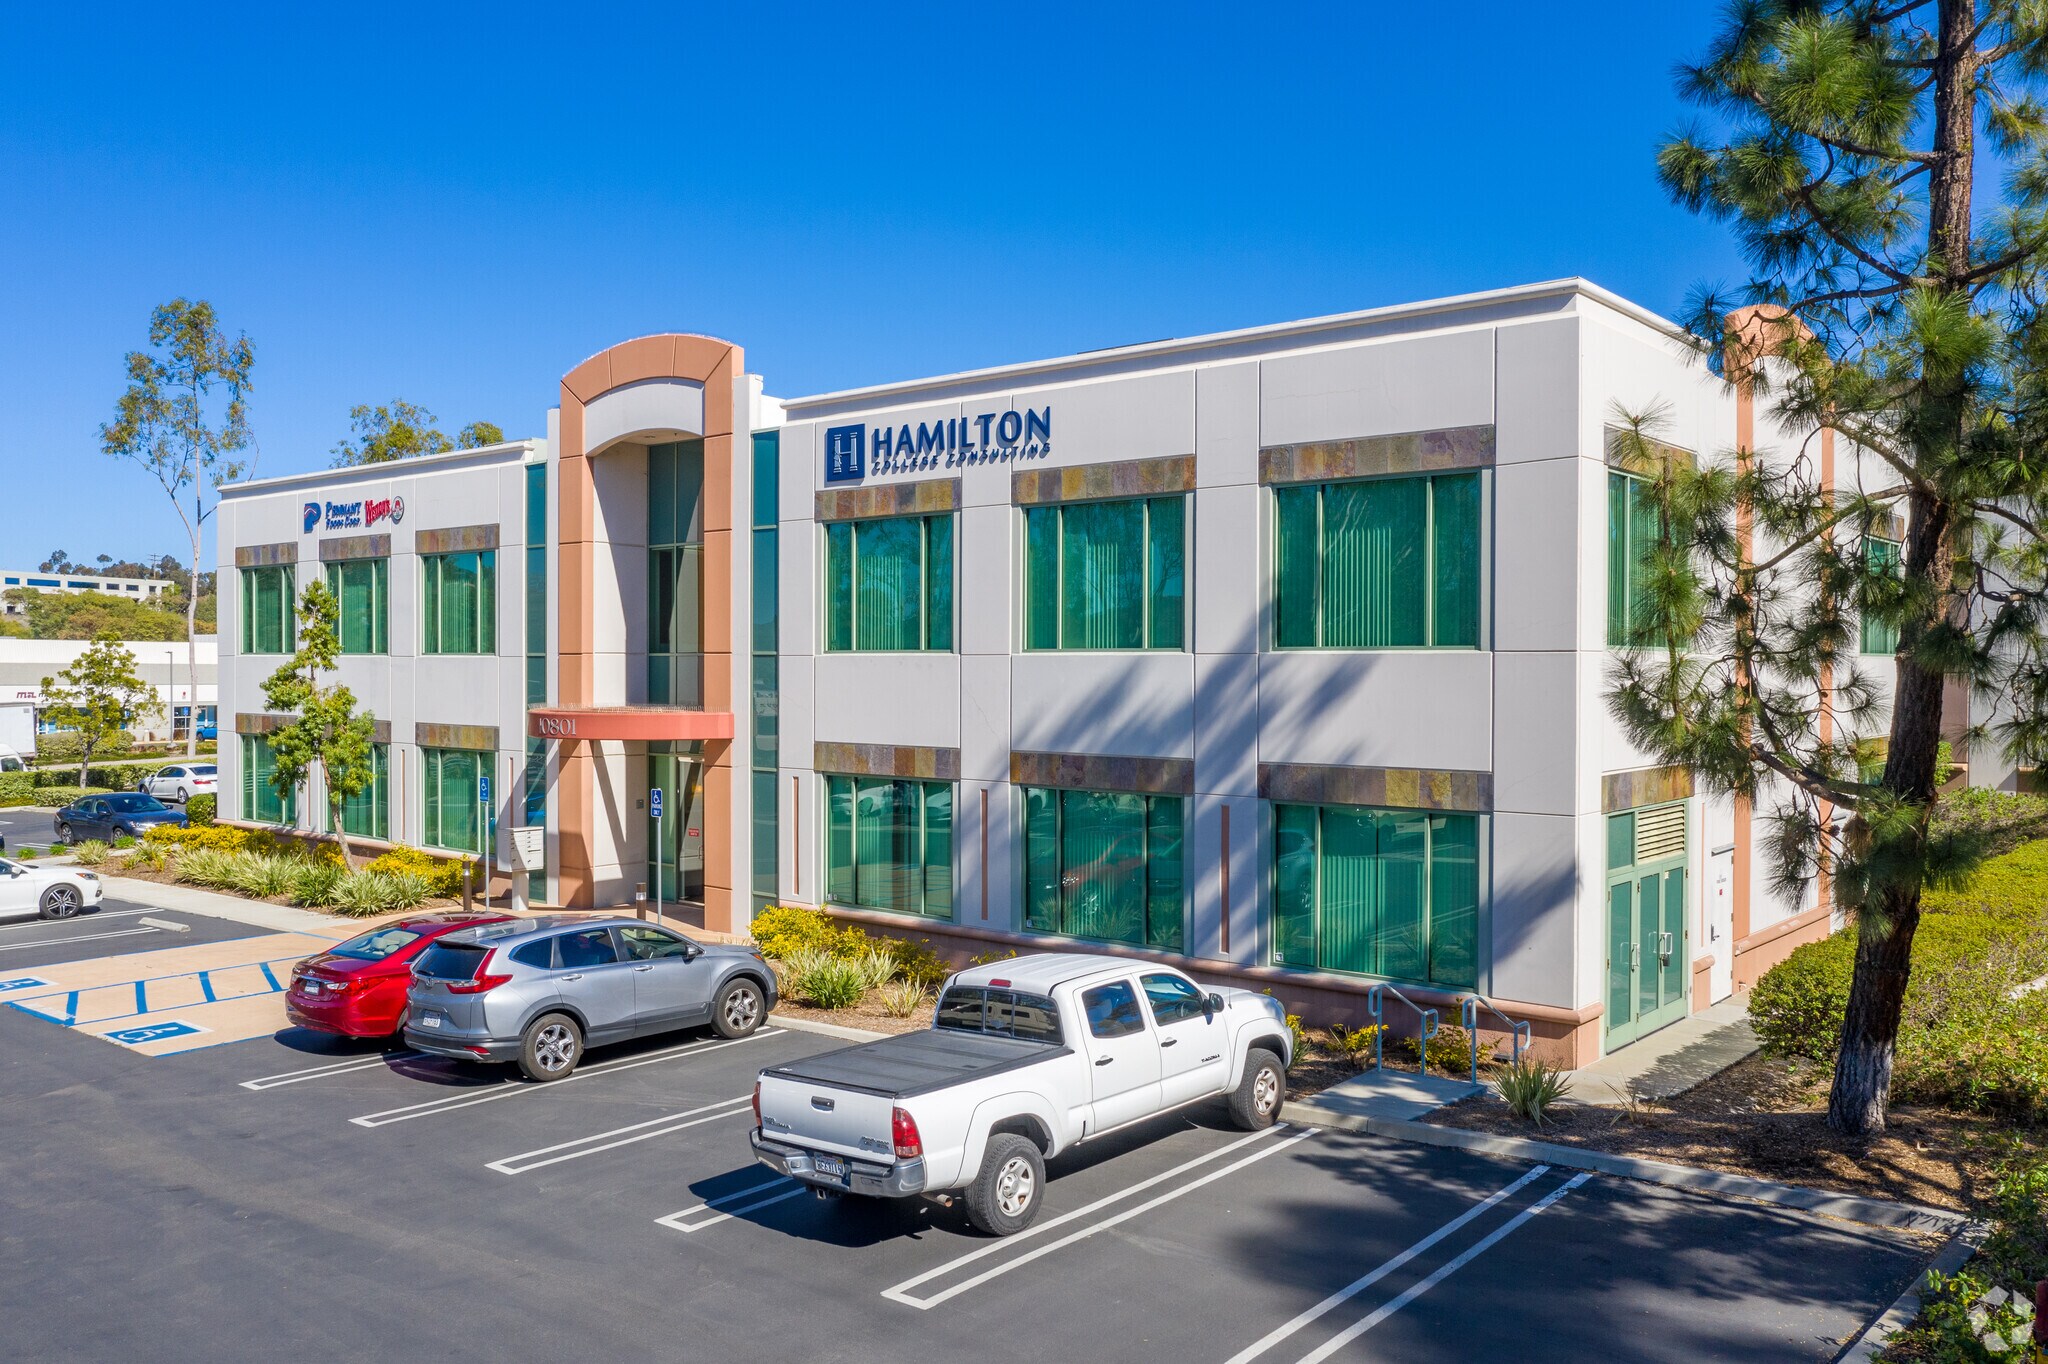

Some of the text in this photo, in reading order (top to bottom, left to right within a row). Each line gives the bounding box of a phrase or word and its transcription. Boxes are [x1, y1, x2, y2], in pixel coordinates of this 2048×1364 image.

[874, 406, 1051, 458] HAMILTON
[874, 442, 1051, 471] COLLEGE CONSULTING
[539, 717, 577, 736] 10801
